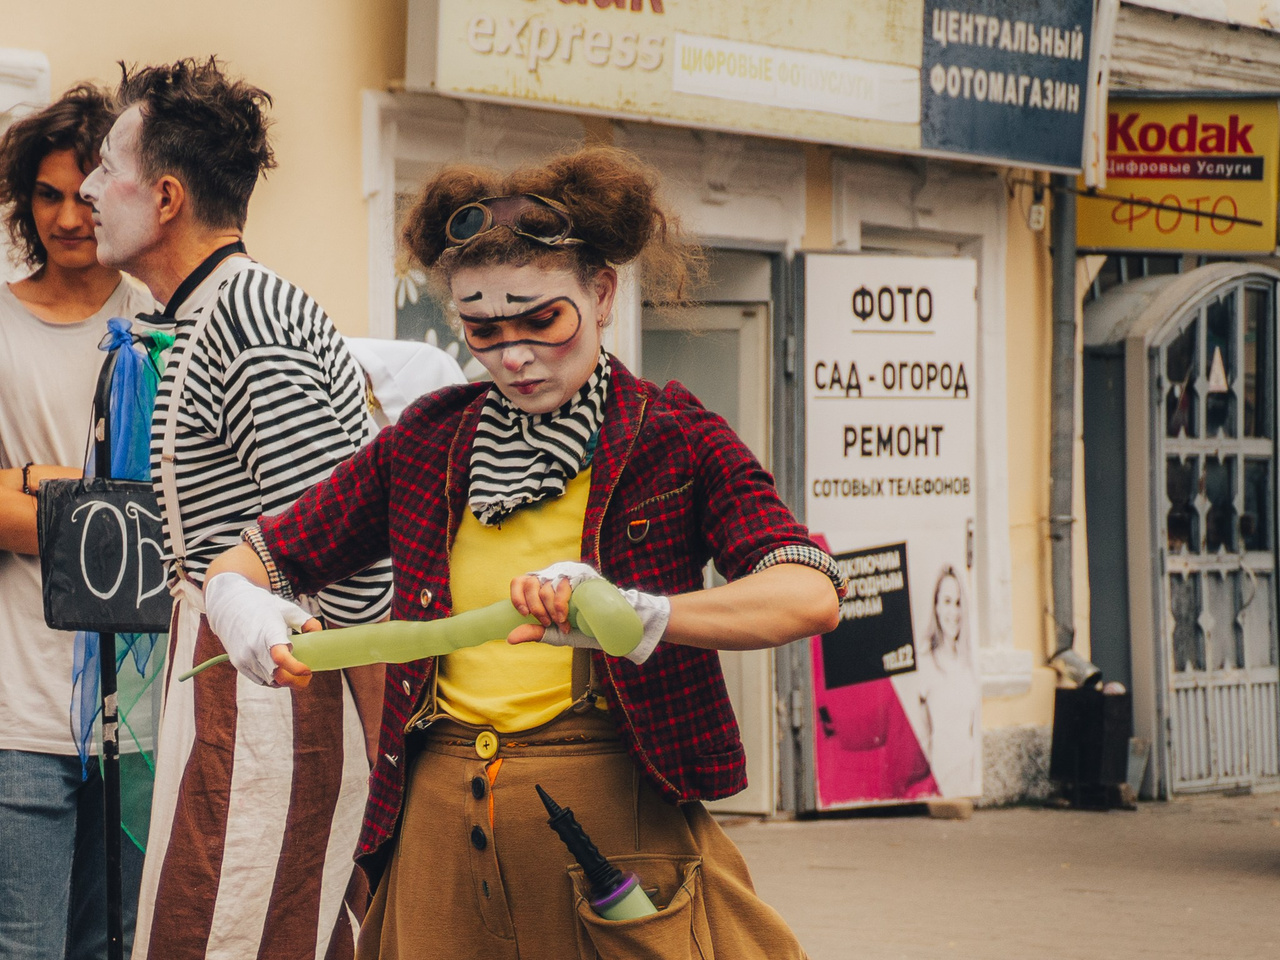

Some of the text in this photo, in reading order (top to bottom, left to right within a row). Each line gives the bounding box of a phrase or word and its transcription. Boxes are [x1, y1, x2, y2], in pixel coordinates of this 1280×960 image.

[469, 12, 667, 73] express
[932, 8, 1084, 61] ЦЕНТРАЛЬНЫЙ
[681, 44, 774, 82] ЦИФРОВЫЕ
[930, 63, 1080, 114] ФОТОМАГАЗИН
[1107, 112, 1254, 154] Kodak
[1197, 160, 1252, 177] Услуги
[1111, 193, 1238, 236] ФОТО
[852, 285, 934, 323] ФОТО
[814, 361, 862, 398] САД
[882, 361, 969, 399] ОГОРОД
[843, 425, 944, 458] РЕМОНТ
[813, 476, 971, 498] СОТОВЫХ ТЕЛЕФОНОВ
[838, 550, 901, 579] ДКЛЮЧИМ
[839, 596, 883, 622] РИФАМ
